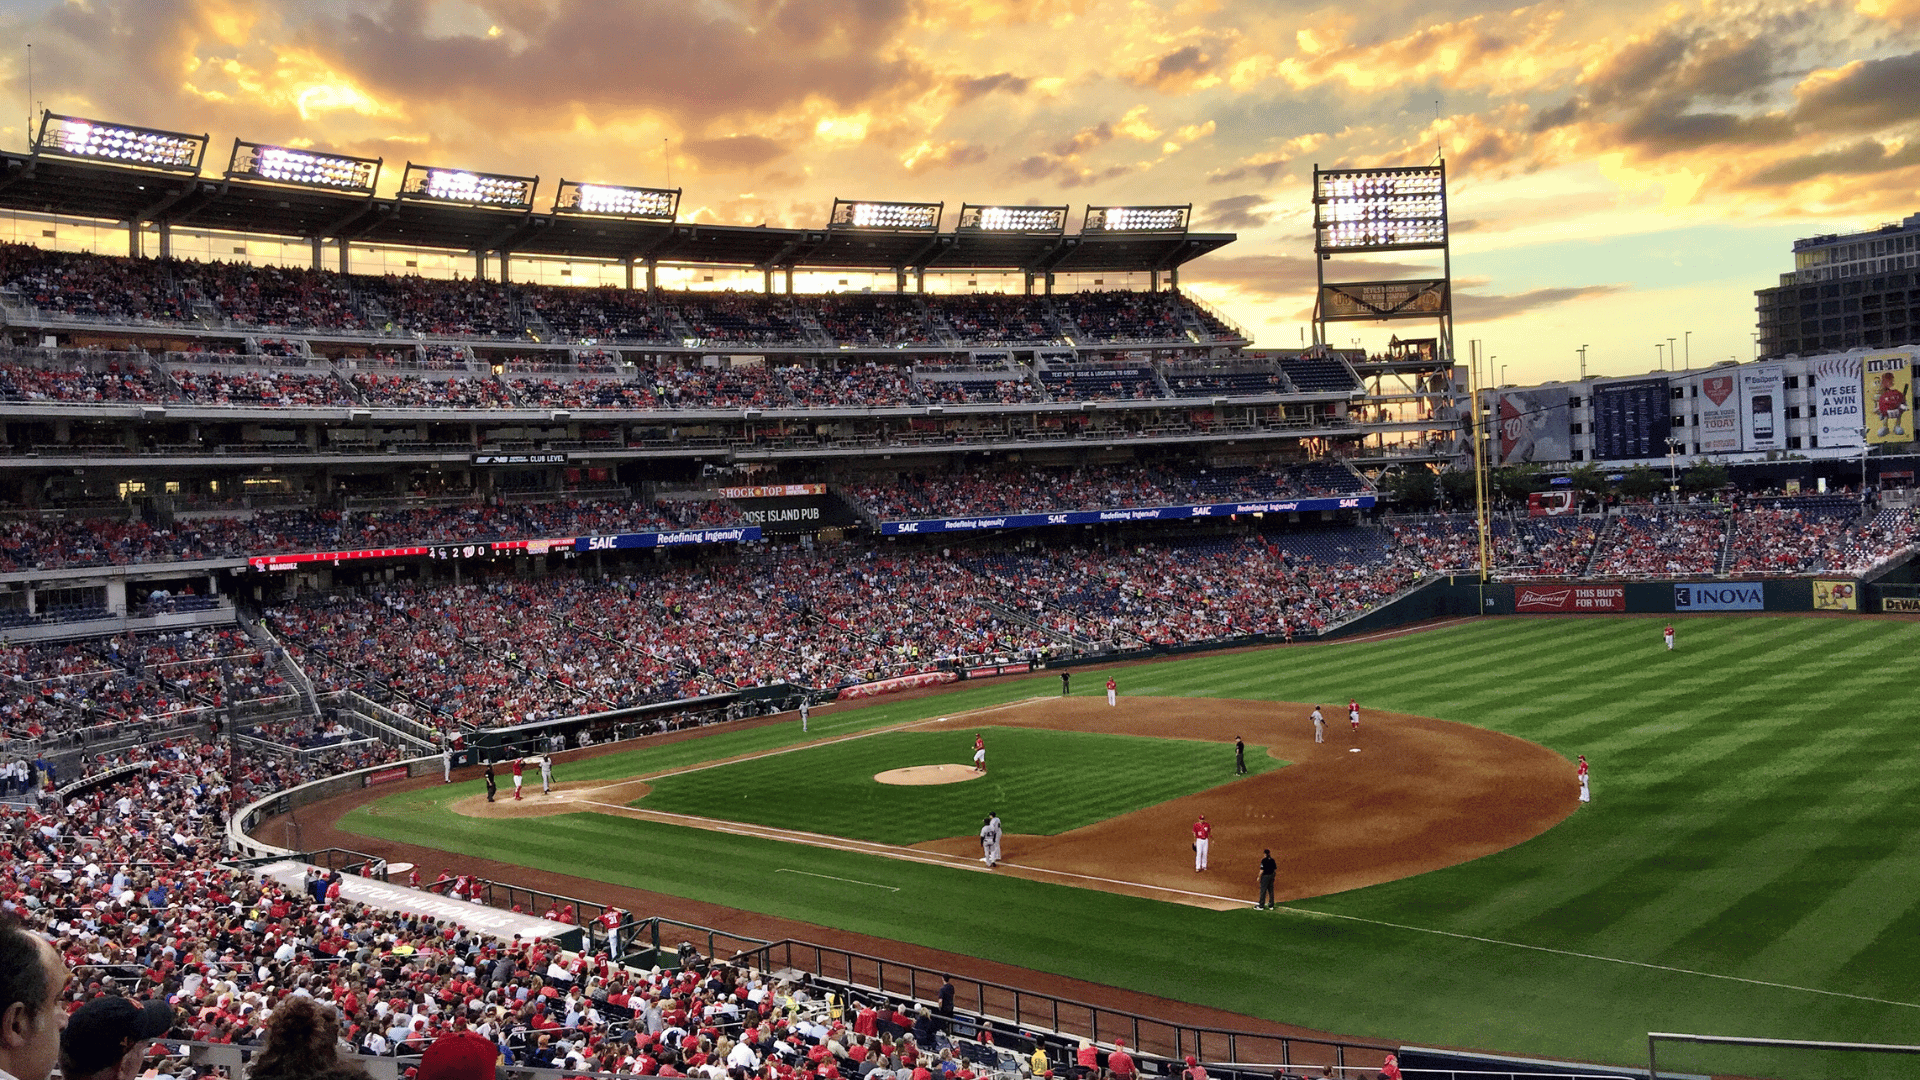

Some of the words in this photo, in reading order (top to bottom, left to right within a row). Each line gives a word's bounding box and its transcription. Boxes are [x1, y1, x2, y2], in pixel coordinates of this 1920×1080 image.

[1821, 387, 1838, 396] WE
[1839, 385, 1857, 394] SEE
[1823, 398, 1830, 406] A
[1833, 396, 1856, 405] WIN
[1822, 406, 1857, 416] AHEAD
[1704, 418, 1736, 428] TODAY
[530, 455, 545, 463] CLUB
[719, 487, 755, 498] SHOCK
[761, 486, 783, 496] TOP
[1236, 503, 1269, 512] Redefining
[1269, 502, 1298, 511] Ingenuity
[1339, 498, 1359, 508] SAIC
[743, 511, 766, 523] OOSE
[767, 508, 800, 521] ISLAND
[801, 507, 820, 520] PUB
[1100, 511, 1131, 520] Redefining
[1131, 510, 1160, 519] Ingenuity
[1191, 506, 1212, 516] SAIC
[945, 520, 977, 529] Redefining
[977, 518, 1006, 528] Ingenuity
[1047, 514, 1068, 524] SAIC
[898, 522, 919, 533] SAIC
[656, 533, 703, 544] Redefining
[704, 529, 744, 542] Ingenuity
[588, 536, 618, 550] SAIC
[452, 547, 459, 558] 2
[478, 546, 485, 556] 0
[269, 562, 298, 571] MARQUEZ
[1575, 589, 1595, 597] THIS
[1596, 588, 1623, 597] BUD'S
[1696, 589, 1762, 604] INOVA
[1522, 594, 1566, 603] Budweiser
[1575, 599, 1593, 608] FOR
[1594, 598, 1615, 607] YOU.
[396, 894, 515, 929] NATIONALS
[609, 915, 618, 925] 31
